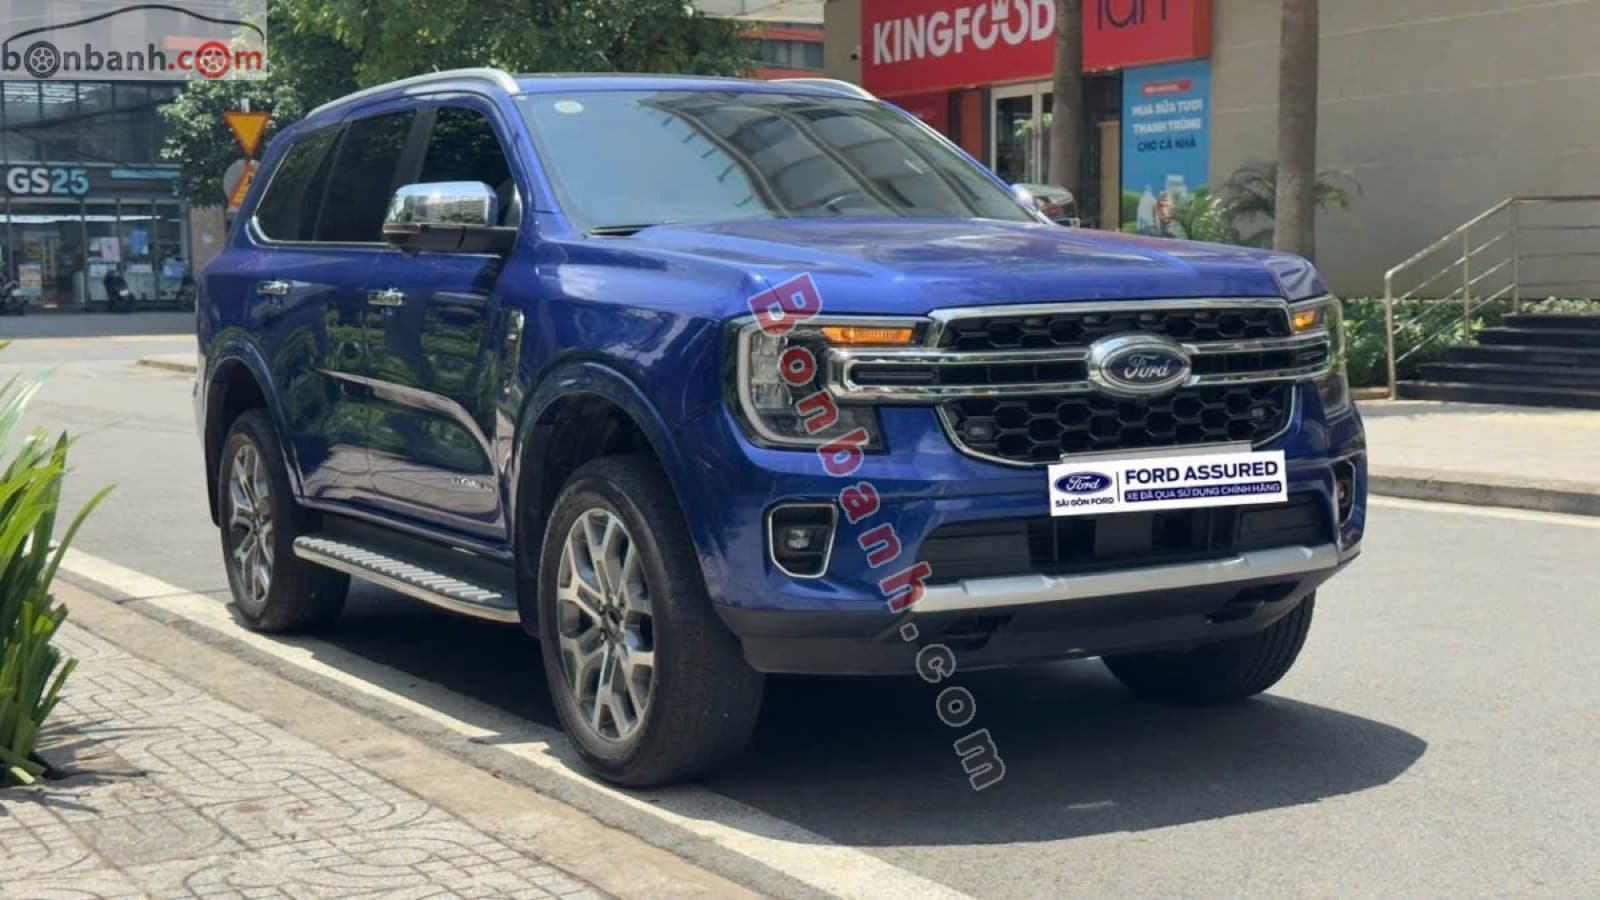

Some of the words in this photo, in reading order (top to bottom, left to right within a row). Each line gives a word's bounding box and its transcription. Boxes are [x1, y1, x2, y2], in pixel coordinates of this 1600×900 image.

[873, 0, 1056, 65] KINGFOOD
[7, 168, 88, 194] GS25
[1124, 353, 1170, 379] Ford
[1066, 475, 1101, 491] Ford
[1125, 467, 1180, 484] FORD
[1184, 460, 1279, 481] ASSURED
[1091, 497, 1115, 505] FORD
[1126, 491, 1138, 501] XE
[1154, 488, 1176, 500] QUA
